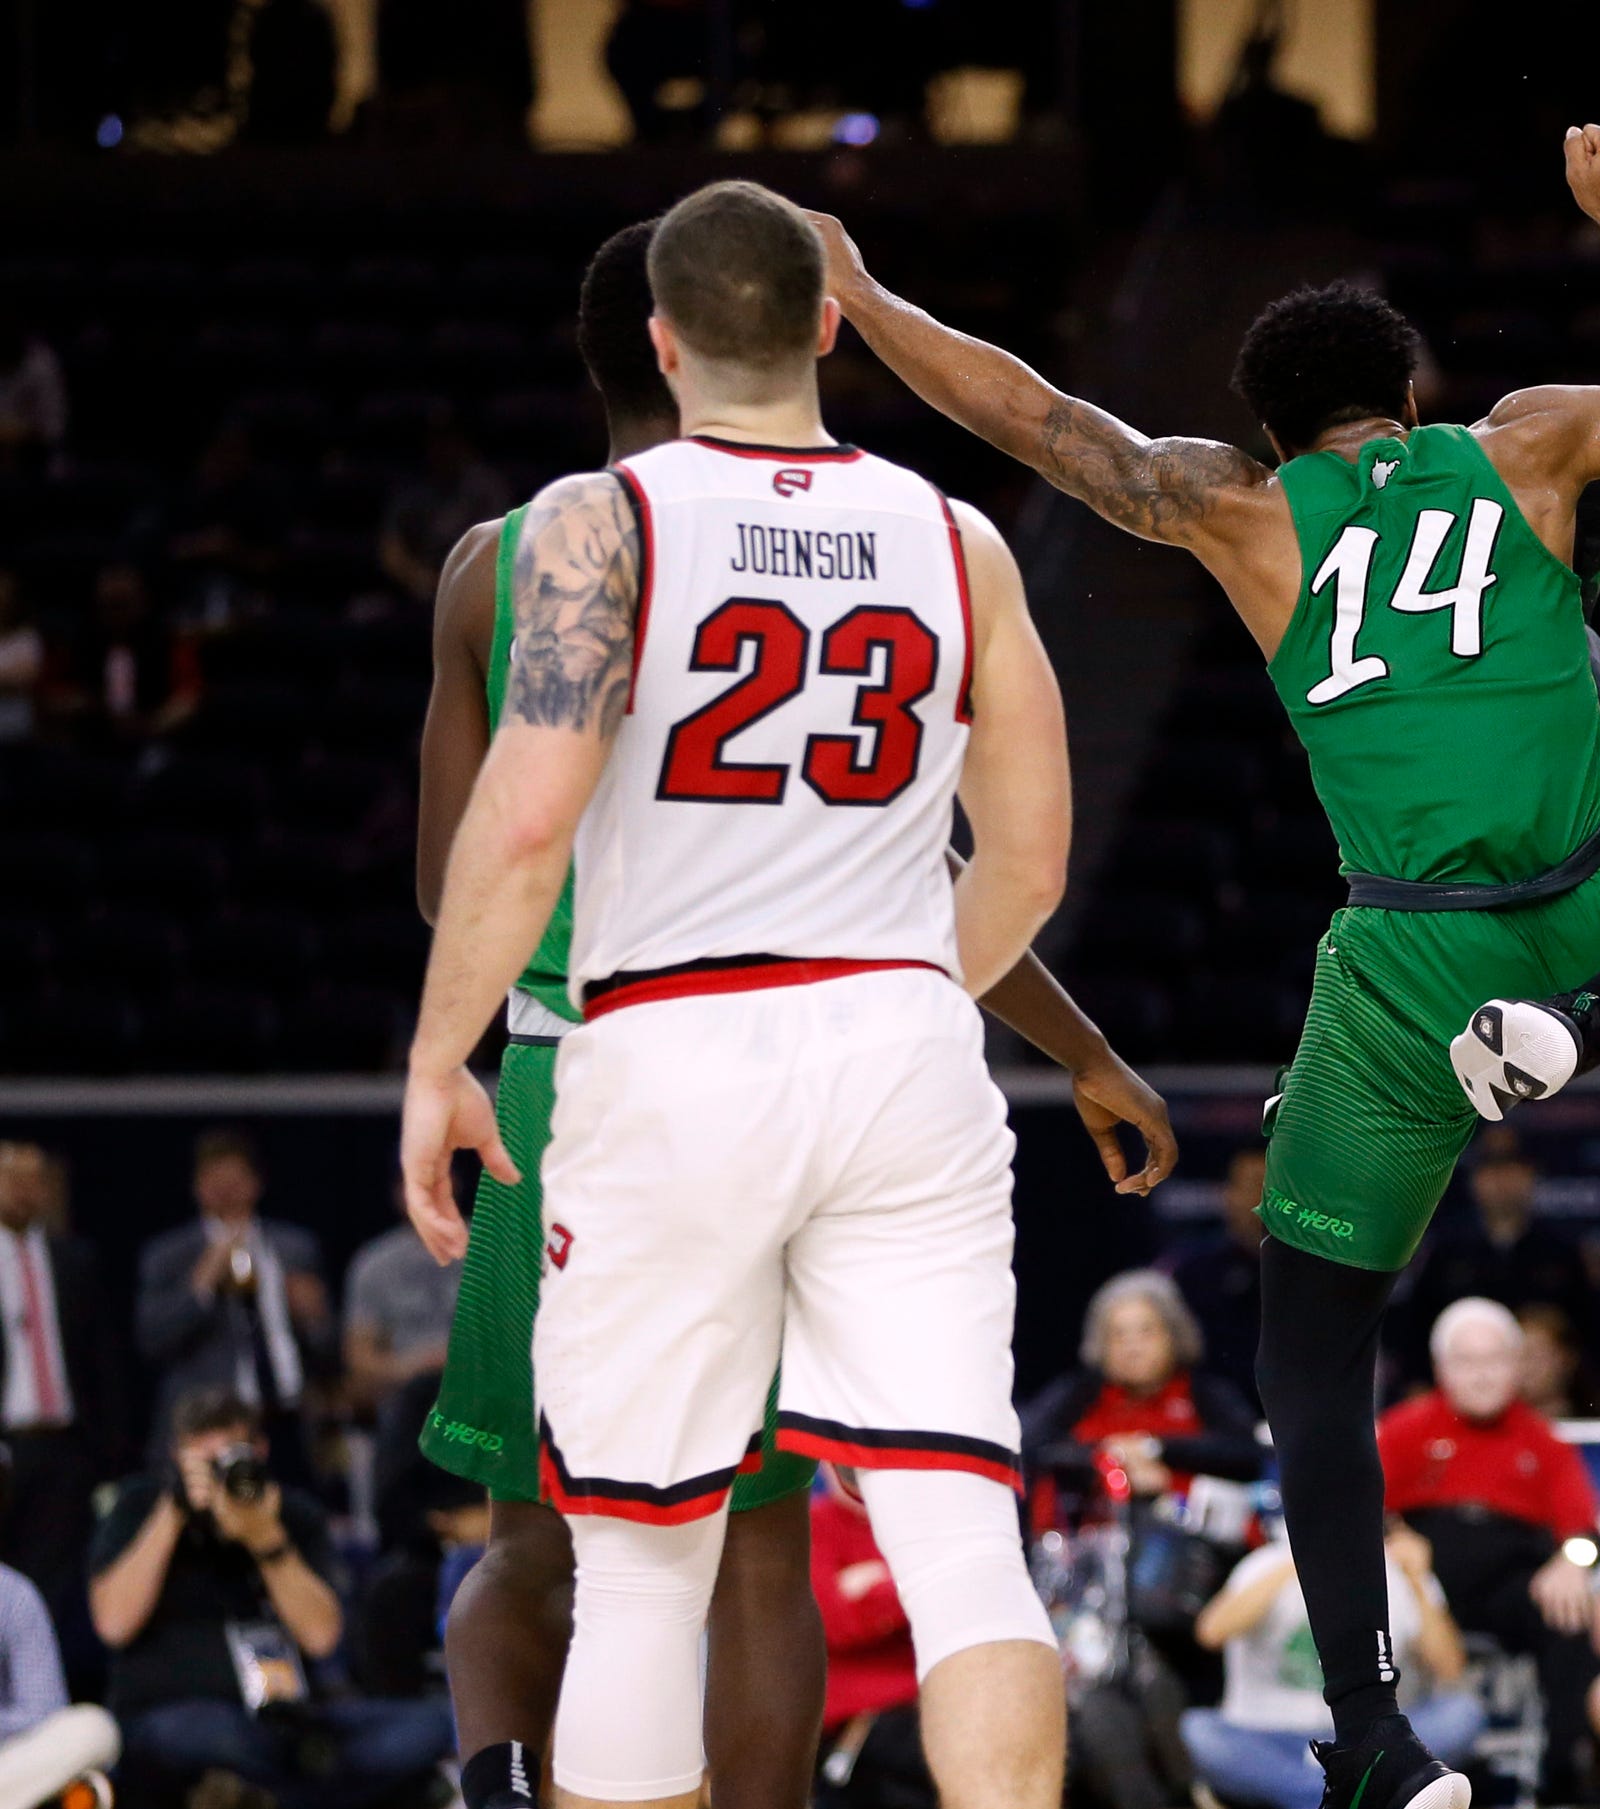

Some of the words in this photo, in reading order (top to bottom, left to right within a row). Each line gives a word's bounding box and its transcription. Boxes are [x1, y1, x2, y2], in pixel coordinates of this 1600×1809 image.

[731, 523, 878, 581] JOHNSON
[1305, 497, 1505, 706] 14
[655, 597, 940, 807] 23
[1267, 1187, 1299, 1215] THE
